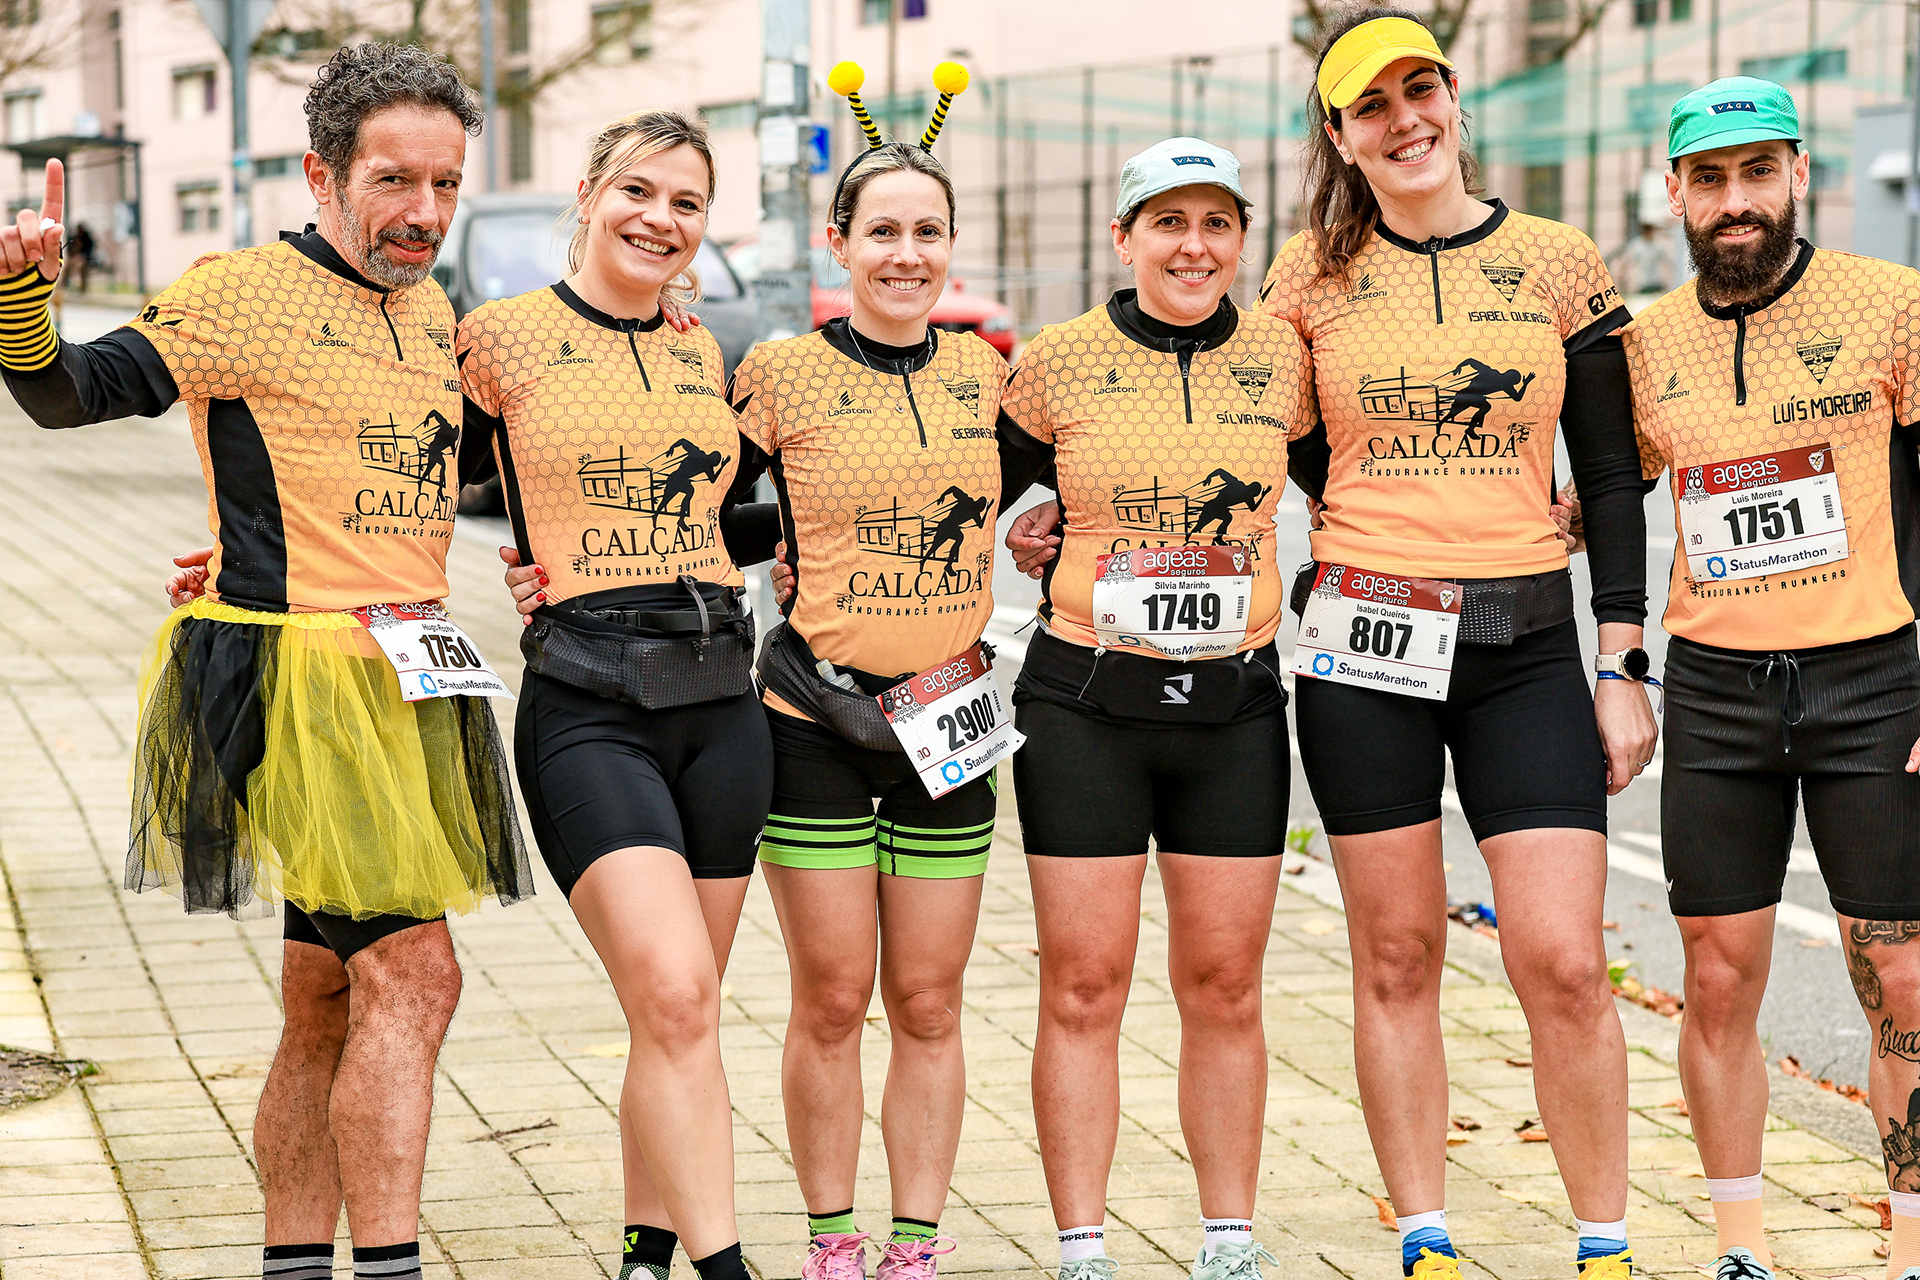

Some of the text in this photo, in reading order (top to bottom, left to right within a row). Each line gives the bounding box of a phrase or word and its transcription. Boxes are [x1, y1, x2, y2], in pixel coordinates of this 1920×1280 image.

[1468, 311, 1509, 322] ISABEL
[547, 356, 594, 367] Lacatoni
[1093, 386, 1138, 396] Lacatoni
[1657, 390, 1690, 403] Lacatoni
[827, 407, 873, 417] Lacatoni
[1216, 411, 1254, 424] SÍLVIA
[1773, 391, 1872, 425] LUÍS MOREIRA
[1367, 434, 1519, 465] CALÇADA
[1368, 466, 1520, 477] ENDURANCE RUNNERS
[1712, 457, 1781, 489] ageas
[1741, 475, 1780, 489] seguros
[1750, 489, 1783, 501] Moreira
[1723, 498, 1805, 546] 1751
[581, 523, 716, 563] CALÇADA
[1143, 551, 1208, 575] ageas
[1730, 546, 1828, 572] StatusMarathon
[585, 566, 669, 577] ENDURANCE
[1170, 569, 1206, 577] seguros
[848, 567, 983, 605] CALÇADA
[1178, 581, 1211, 590] Marinho
[1351, 573, 1411, 598] ageas
[1701, 569, 1846, 598] ENDURANCE RUNNERS
[1373, 594, 1408, 606] seguros
[847, 605, 928, 616] ENDURANCE
[1142, 593, 1221, 631] 1749
[1356, 604, 1411, 620] Isabel Queirós
[1349, 616, 1413, 660] 807
[418, 634, 481, 668] 1750
[920, 657, 972, 693] ageas
[949, 674, 974, 691] seguros
[1337, 662, 1428, 689] StatusMarathon
[937, 692, 996, 751] 2900
